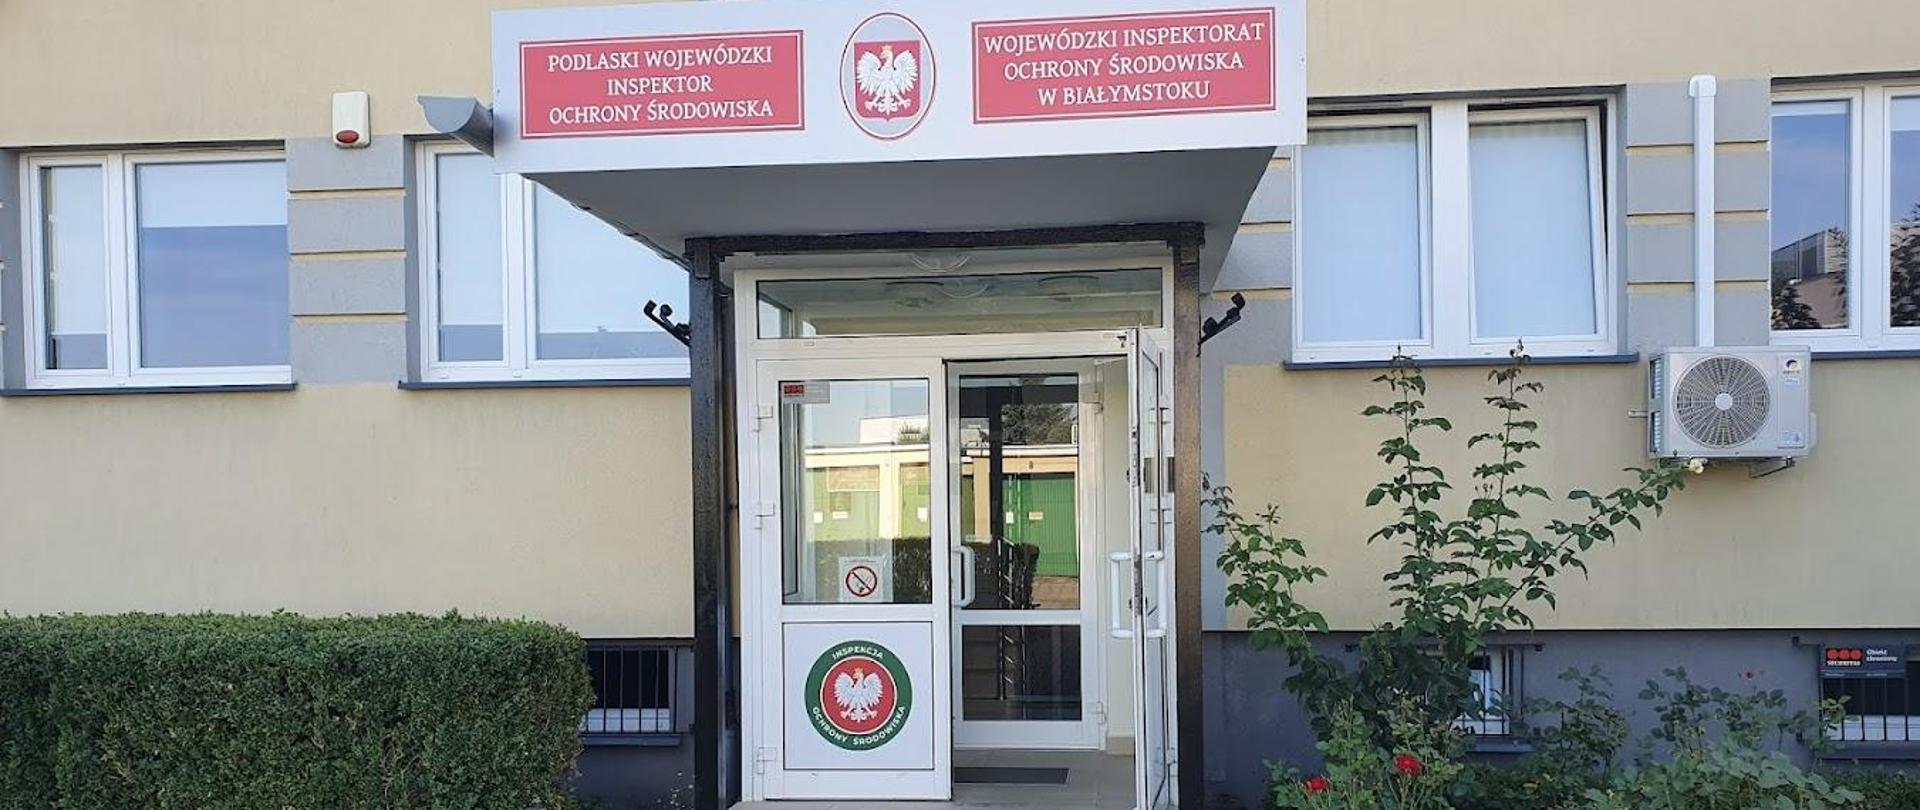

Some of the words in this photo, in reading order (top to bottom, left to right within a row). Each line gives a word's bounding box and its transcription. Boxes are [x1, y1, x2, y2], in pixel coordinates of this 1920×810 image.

[983, 28, 1118, 56] WOJEWÓDZKI
[1123, 22, 1265, 47] INSPEKTORAT
[548, 52, 639, 72] PODLASKI
[645, 43, 772, 70] WOJEWÓDZKI
[1004, 58, 1104, 80] OCHRONY
[1108, 52, 1244, 75] ŚRODOWISKA
[607, 75, 713, 96] INSPEKTOR
[1038, 88, 1057, 106] W
[1063, 81, 1211, 105] BIAŁYMSTOKU
[549, 104, 642, 124] OCHRONY
[647, 99, 773, 120] ŚRODOWISKA
[832, 646, 884, 660] INSPEKCJA
[812, 706, 848, 743] OCHRONY
